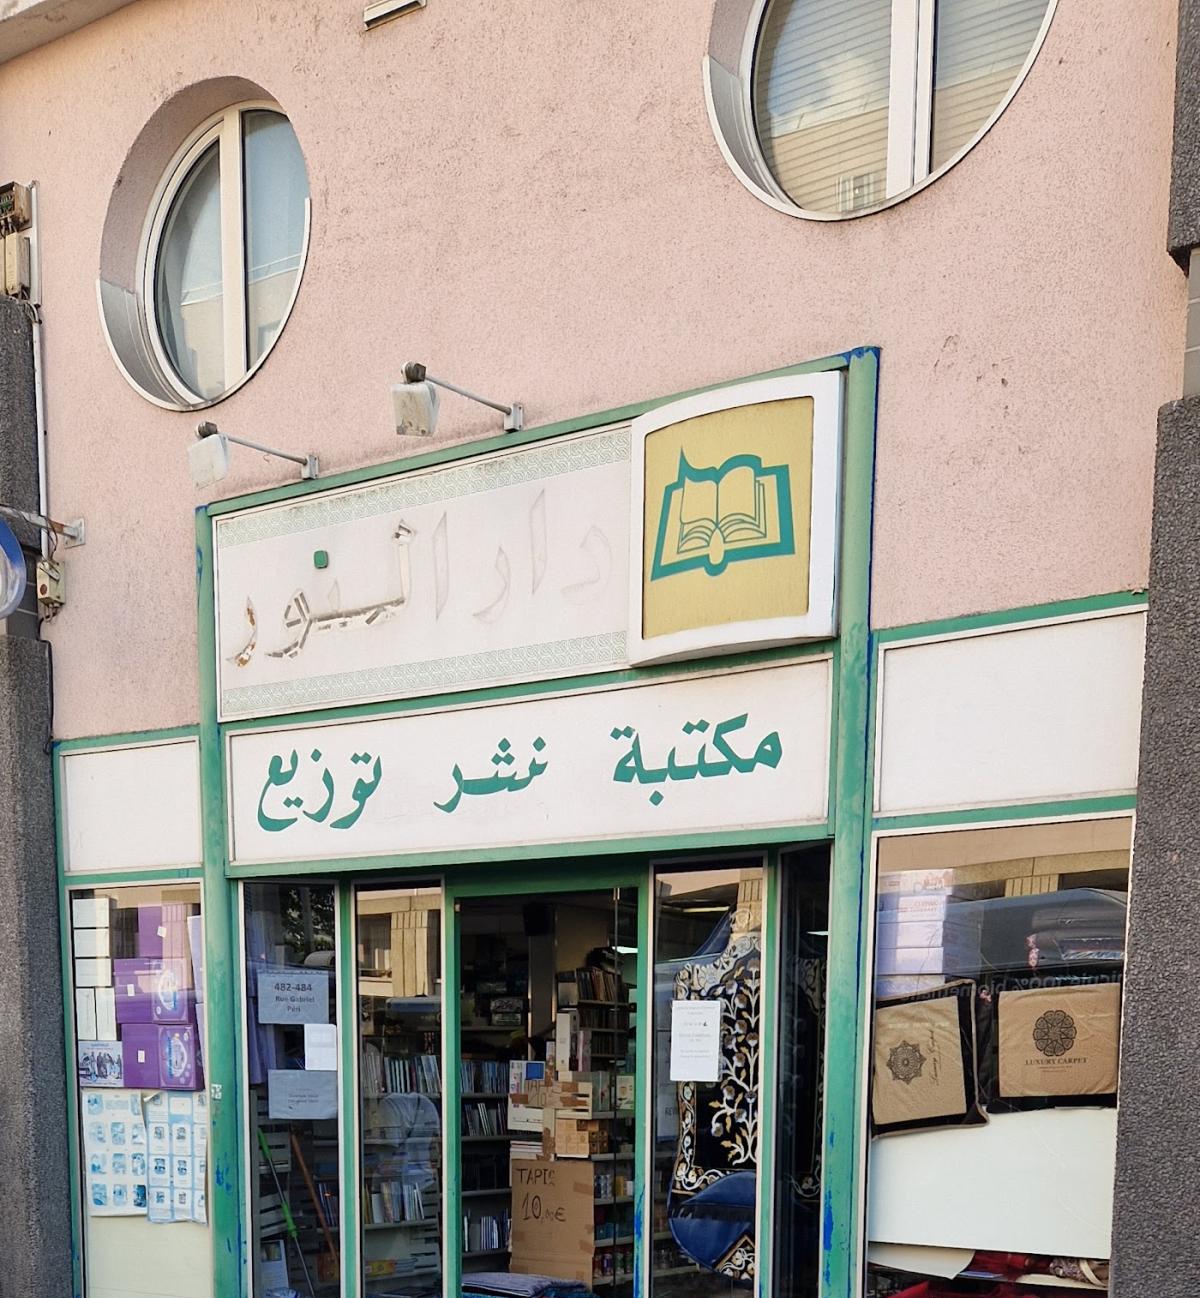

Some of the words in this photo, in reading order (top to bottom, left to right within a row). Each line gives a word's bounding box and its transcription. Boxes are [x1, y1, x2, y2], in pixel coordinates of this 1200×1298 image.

[256, 748, 383, 832] توزيع
[432, 736, 549, 814] نشر
[609, 712, 783, 807] مكتبة
[274, 983, 312, 992] 482-484
[1057, 1056, 1088, 1065] CARPET
